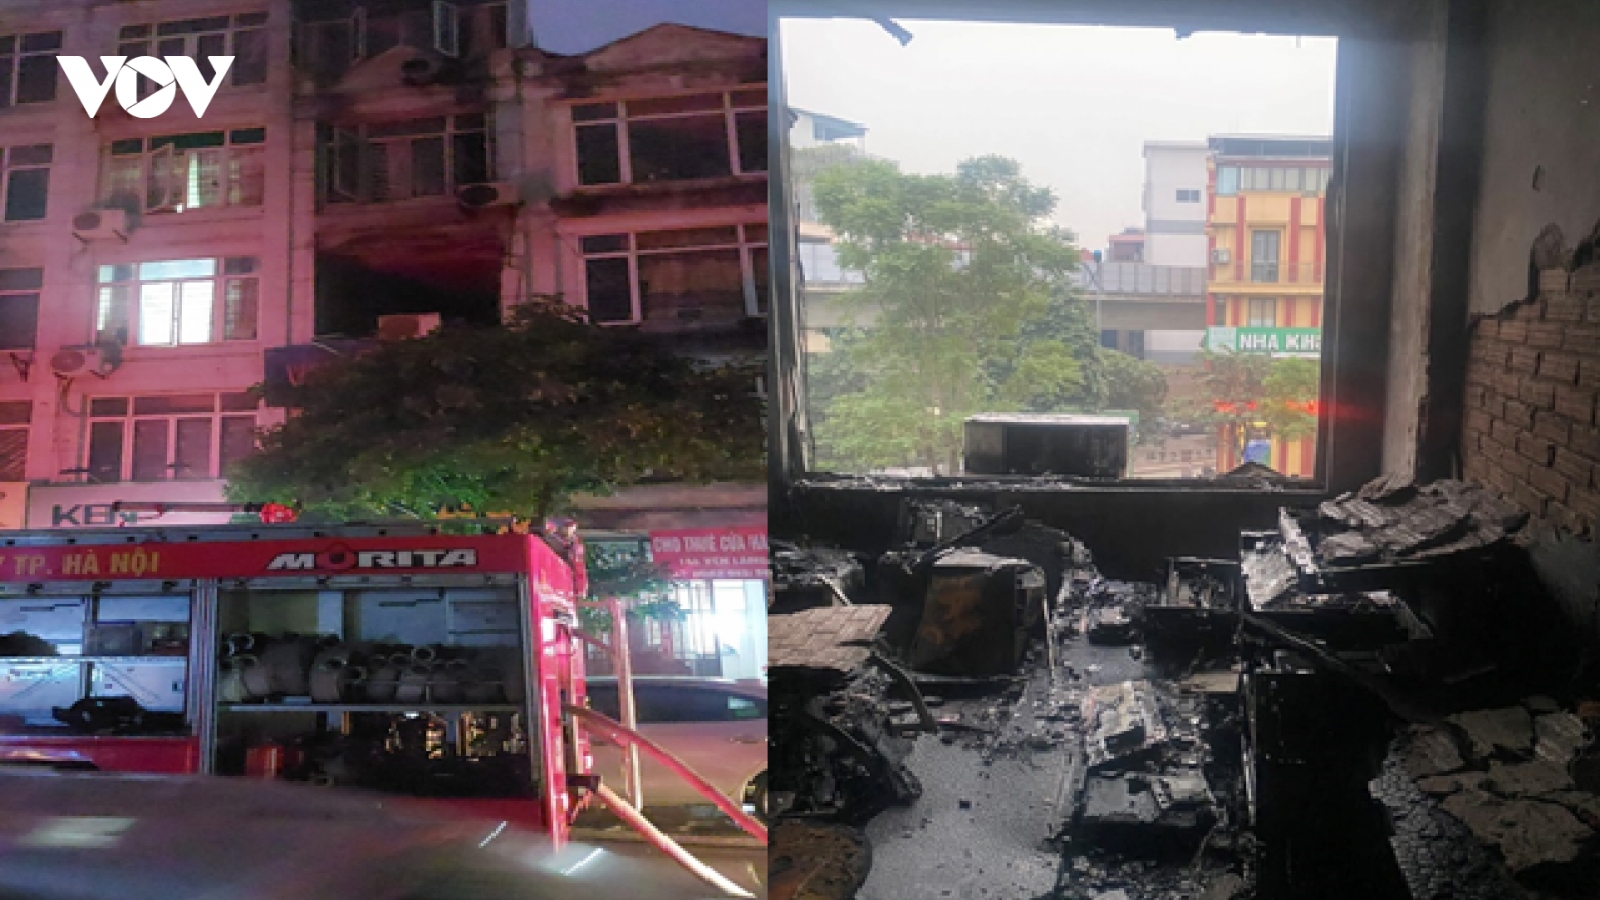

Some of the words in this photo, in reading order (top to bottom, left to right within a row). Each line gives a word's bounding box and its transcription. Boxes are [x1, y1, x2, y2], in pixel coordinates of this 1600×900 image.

[13, 554, 53, 575] TP.
[62, 548, 99, 575] HÀ
[110, 546, 160, 577] NỘI
[267, 545, 477, 571] MORITA
